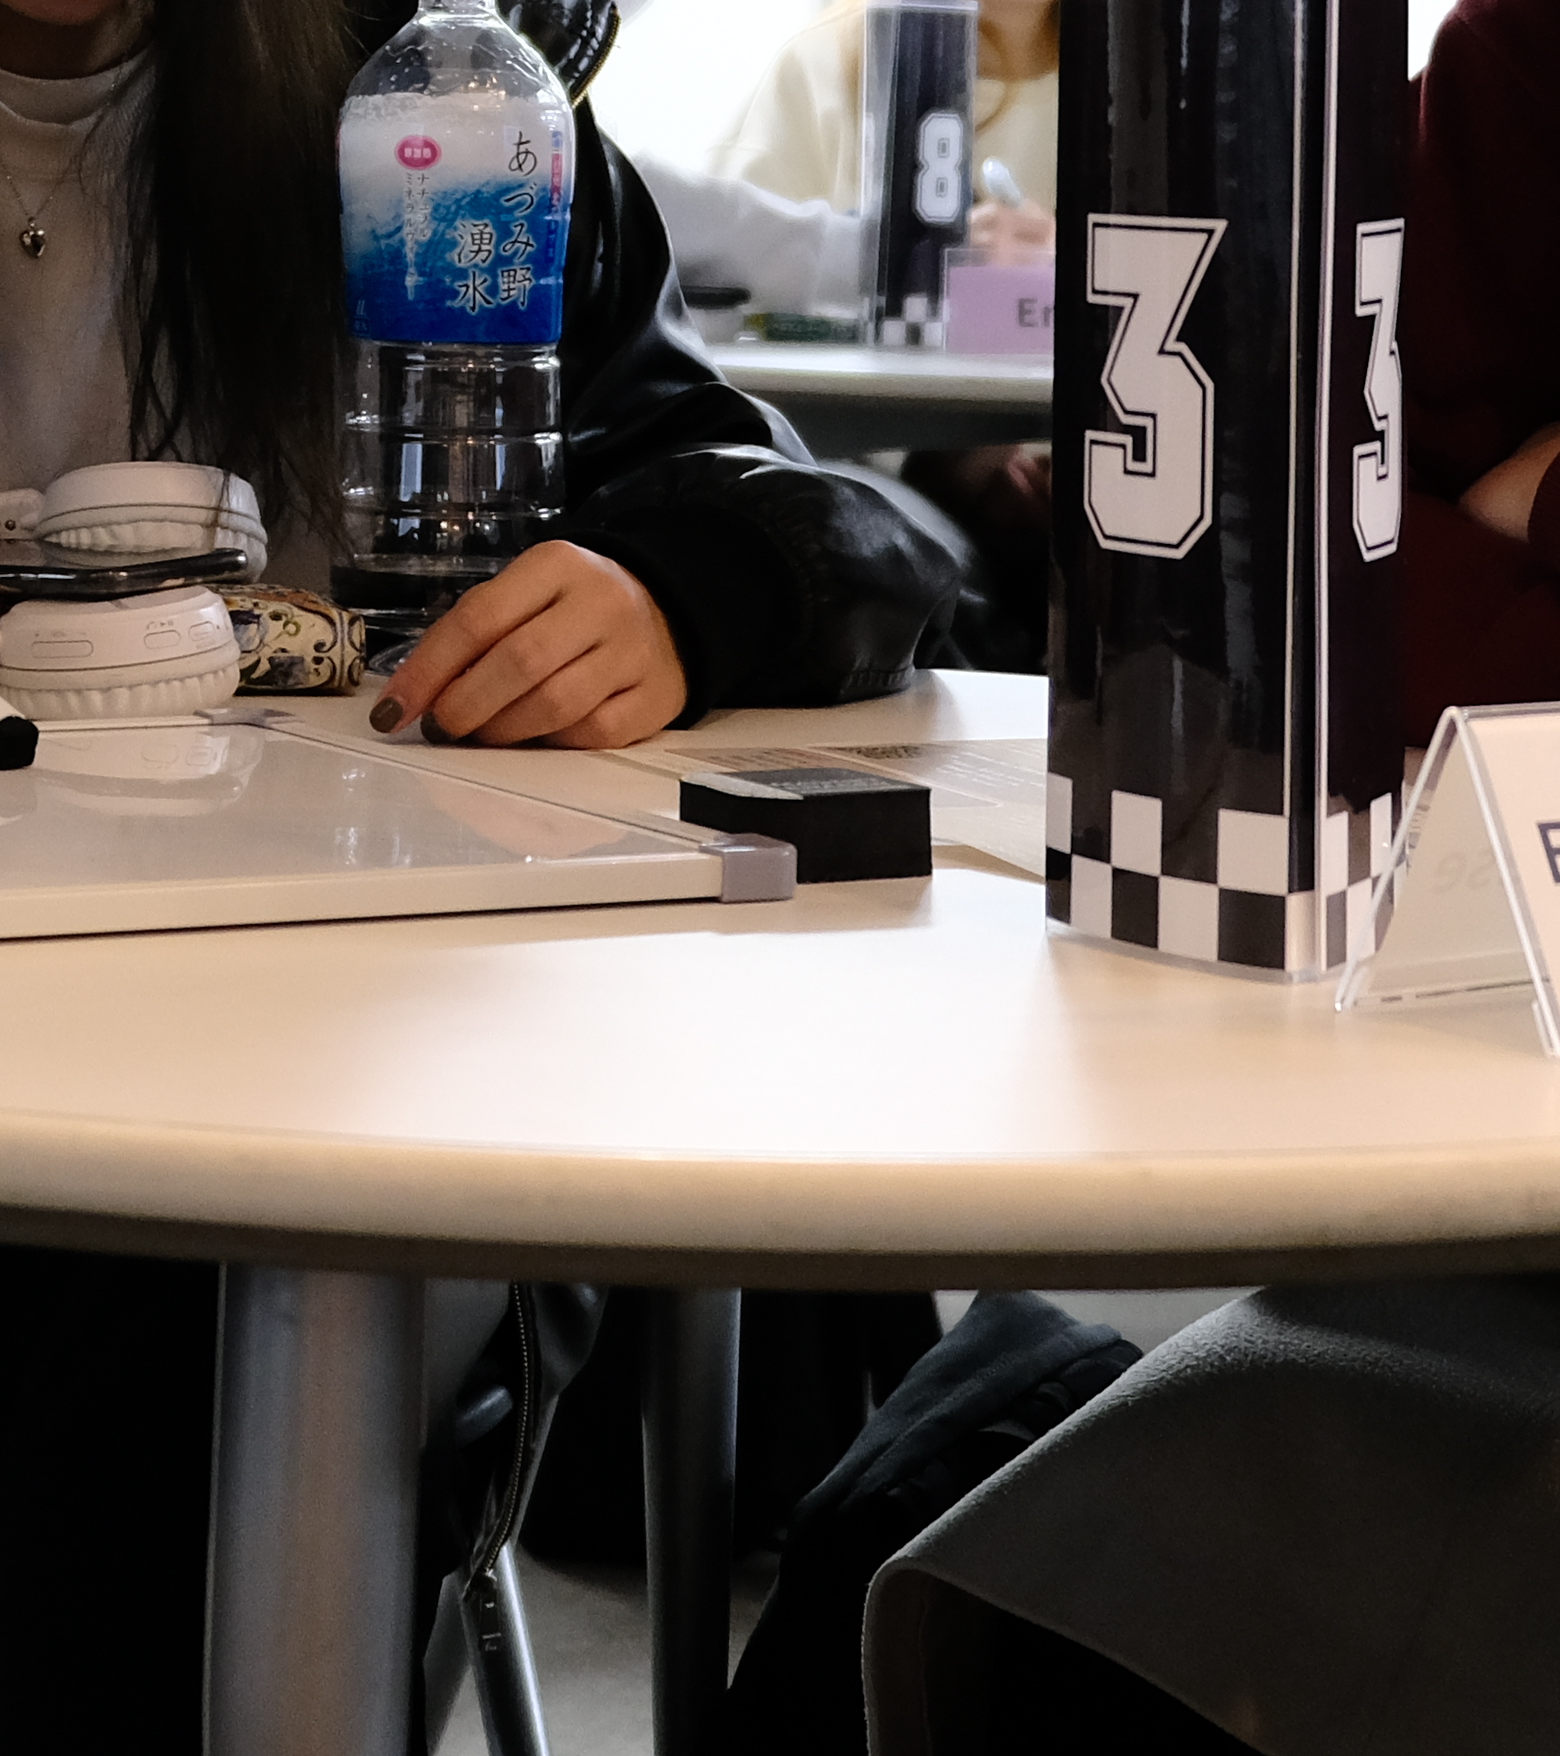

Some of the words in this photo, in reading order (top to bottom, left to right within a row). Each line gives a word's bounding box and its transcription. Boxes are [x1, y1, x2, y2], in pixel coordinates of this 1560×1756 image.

[500, 130, 538, 309] あづみ野
[912, 110, 964, 224] 8
[457, 221, 495, 313] 湧水
[1083, 213, 1228, 559] 3
[1352, 218, 1405, 562] 3
